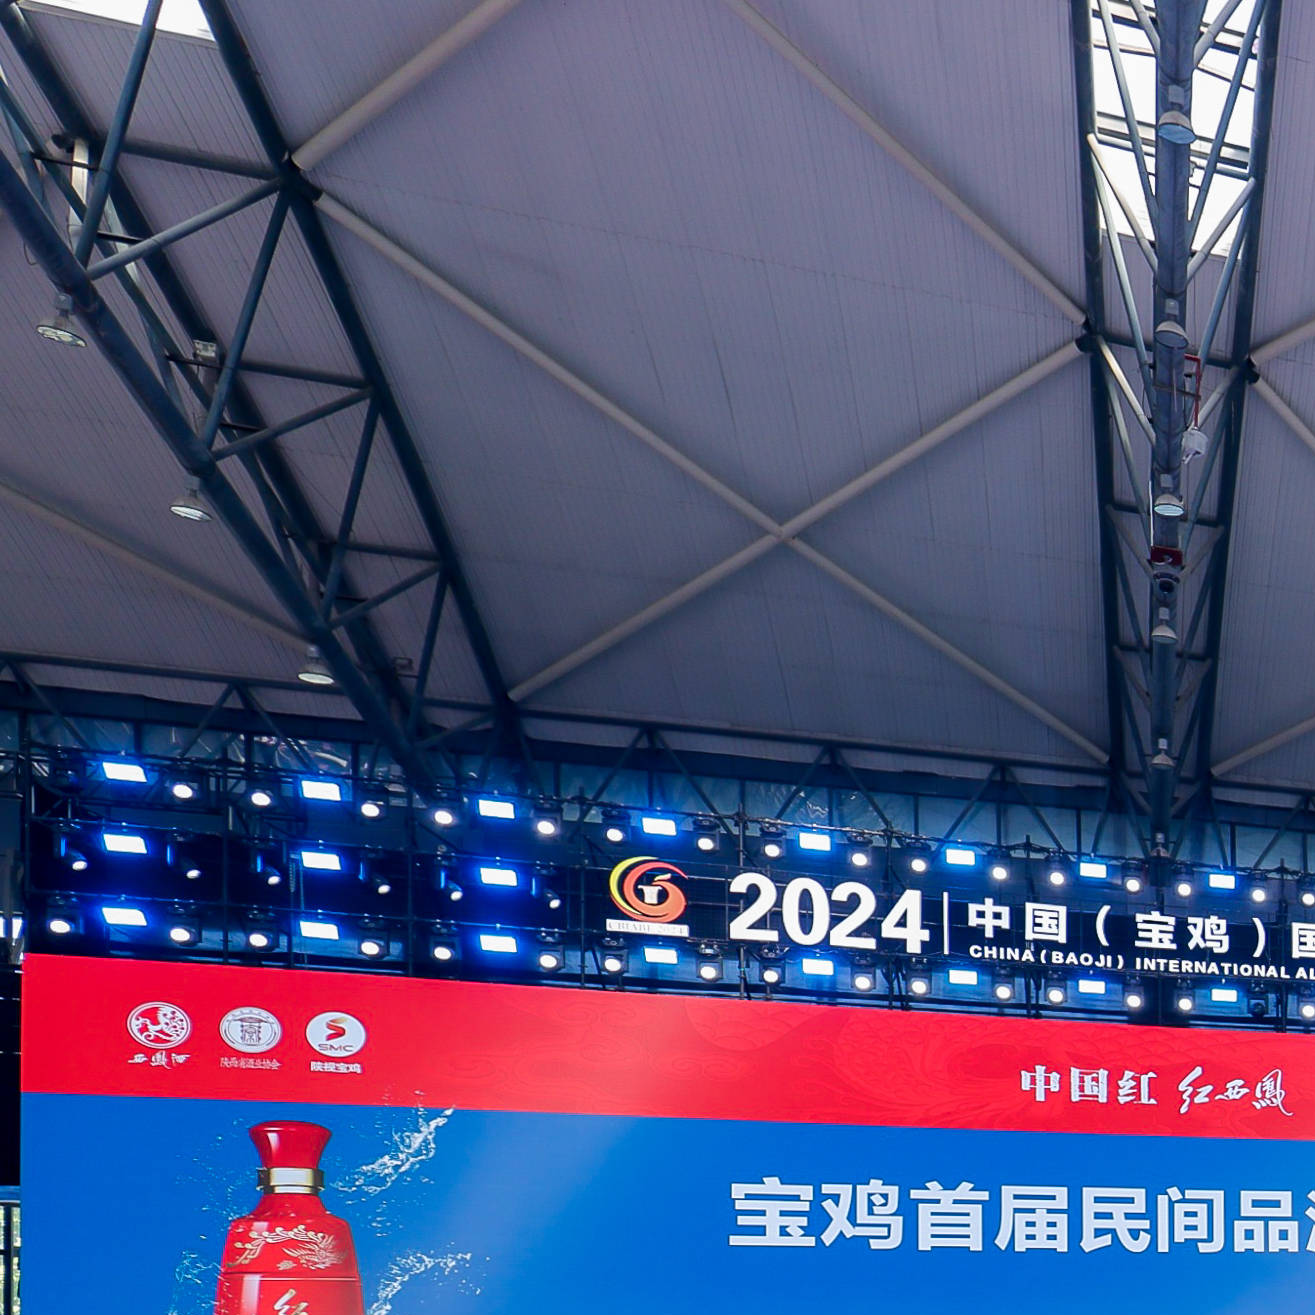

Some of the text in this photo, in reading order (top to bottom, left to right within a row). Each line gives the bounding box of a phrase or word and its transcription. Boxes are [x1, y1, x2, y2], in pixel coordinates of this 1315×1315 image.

[728, 872, 930, 954] 2024
[969, 945, 1035, 962] CHINA
[1136, 957, 1290, 979] INTERNATIONAL
[318, 1043, 353, 1052] SMC
[1020, 1064, 1158, 1106] 中国红
